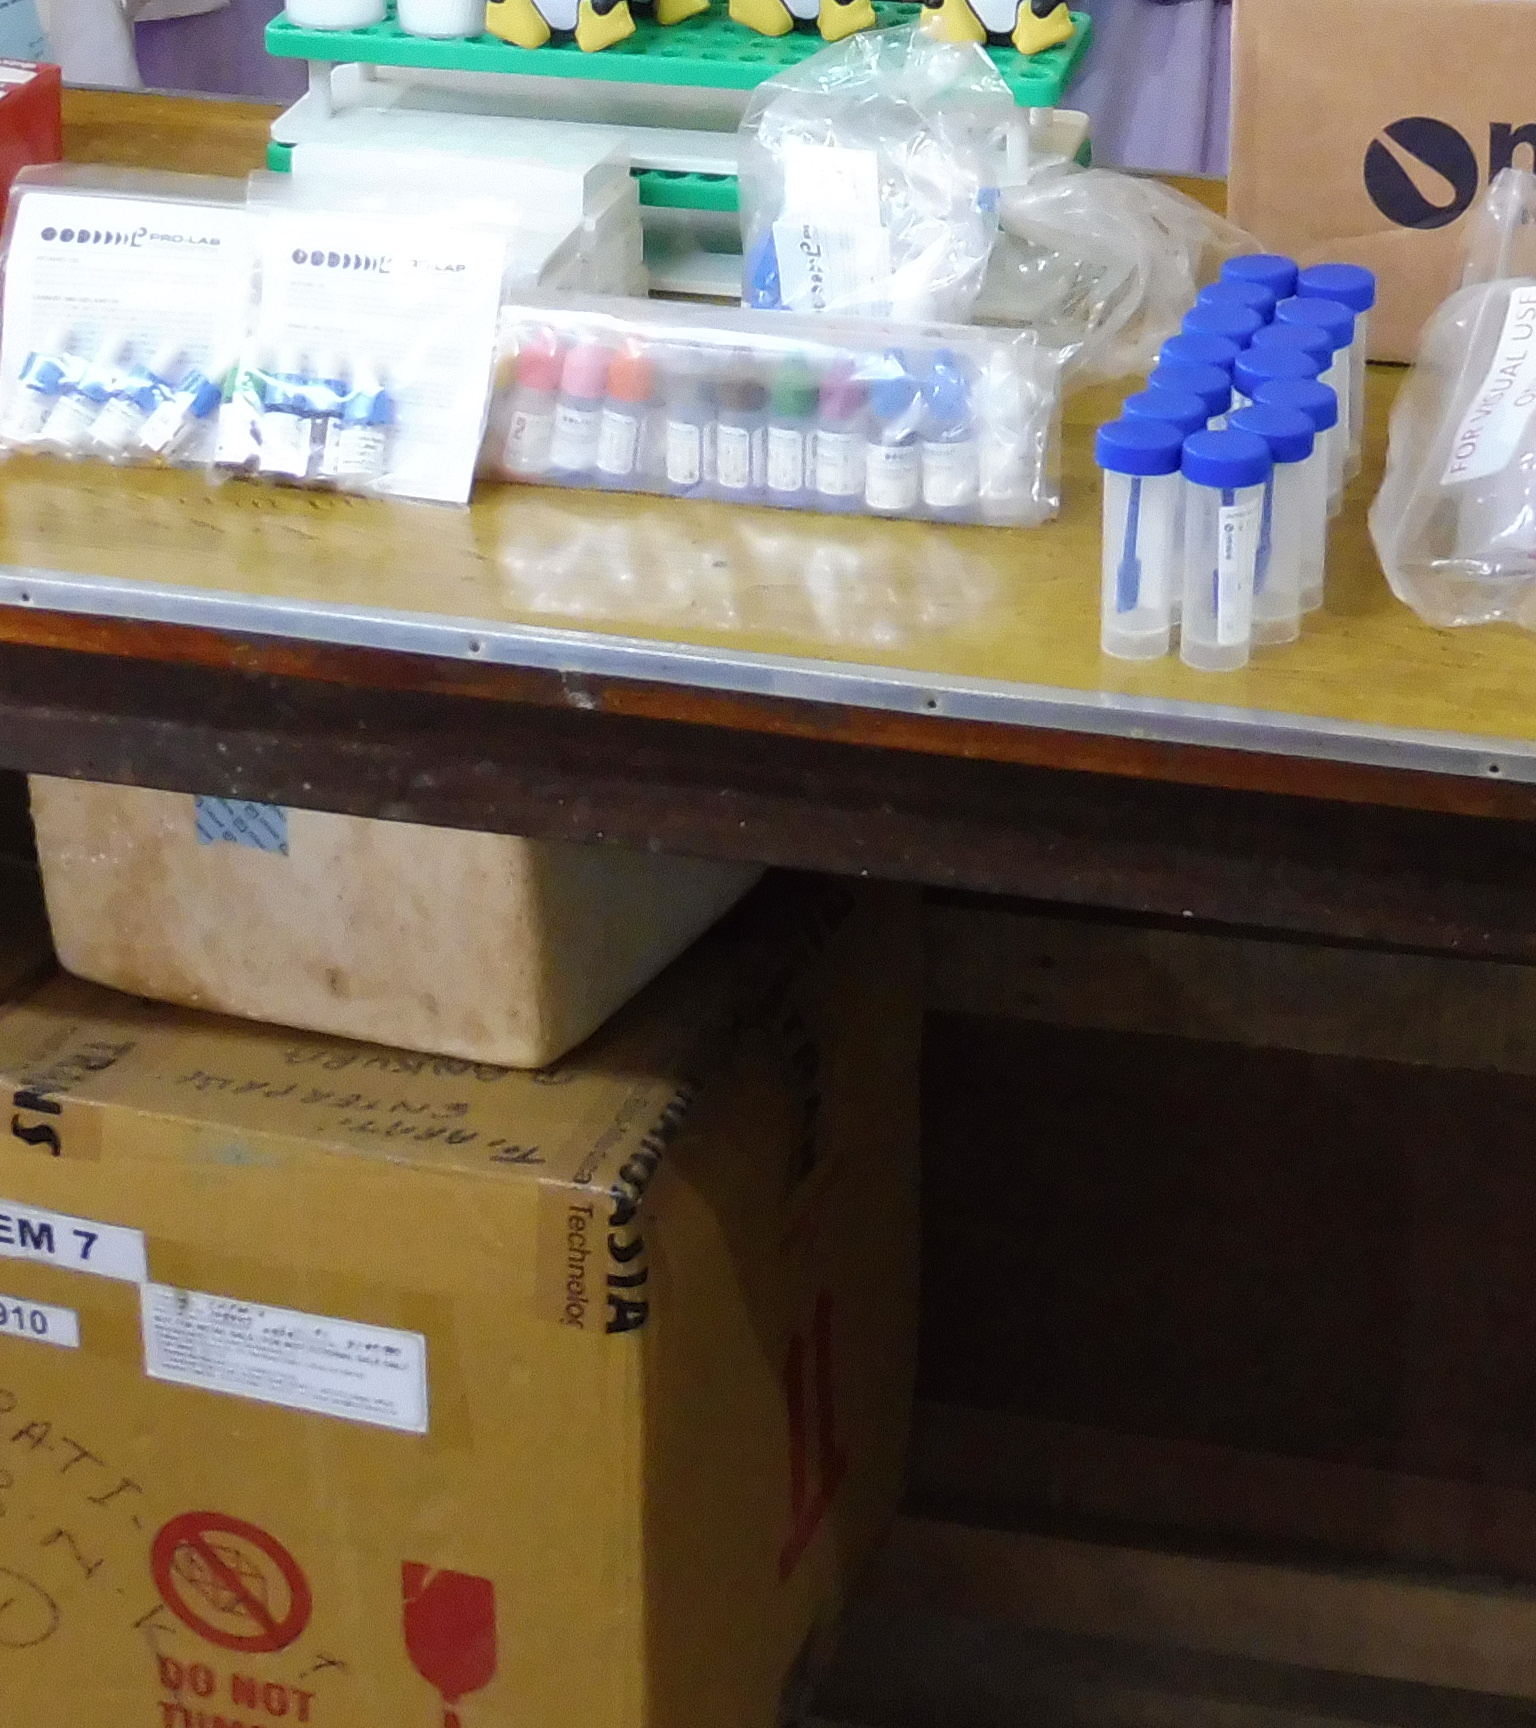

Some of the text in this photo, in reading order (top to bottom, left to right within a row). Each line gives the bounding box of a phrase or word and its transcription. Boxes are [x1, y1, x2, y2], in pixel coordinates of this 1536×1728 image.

[1449, 426, 1484, 474] FOR
[1470, 349, 1529, 423] VISUAL
[72, 1229, 100, 1260] 7
[159, 1656, 216, 1699] DO
[231, 1673, 316, 1723] NOT
